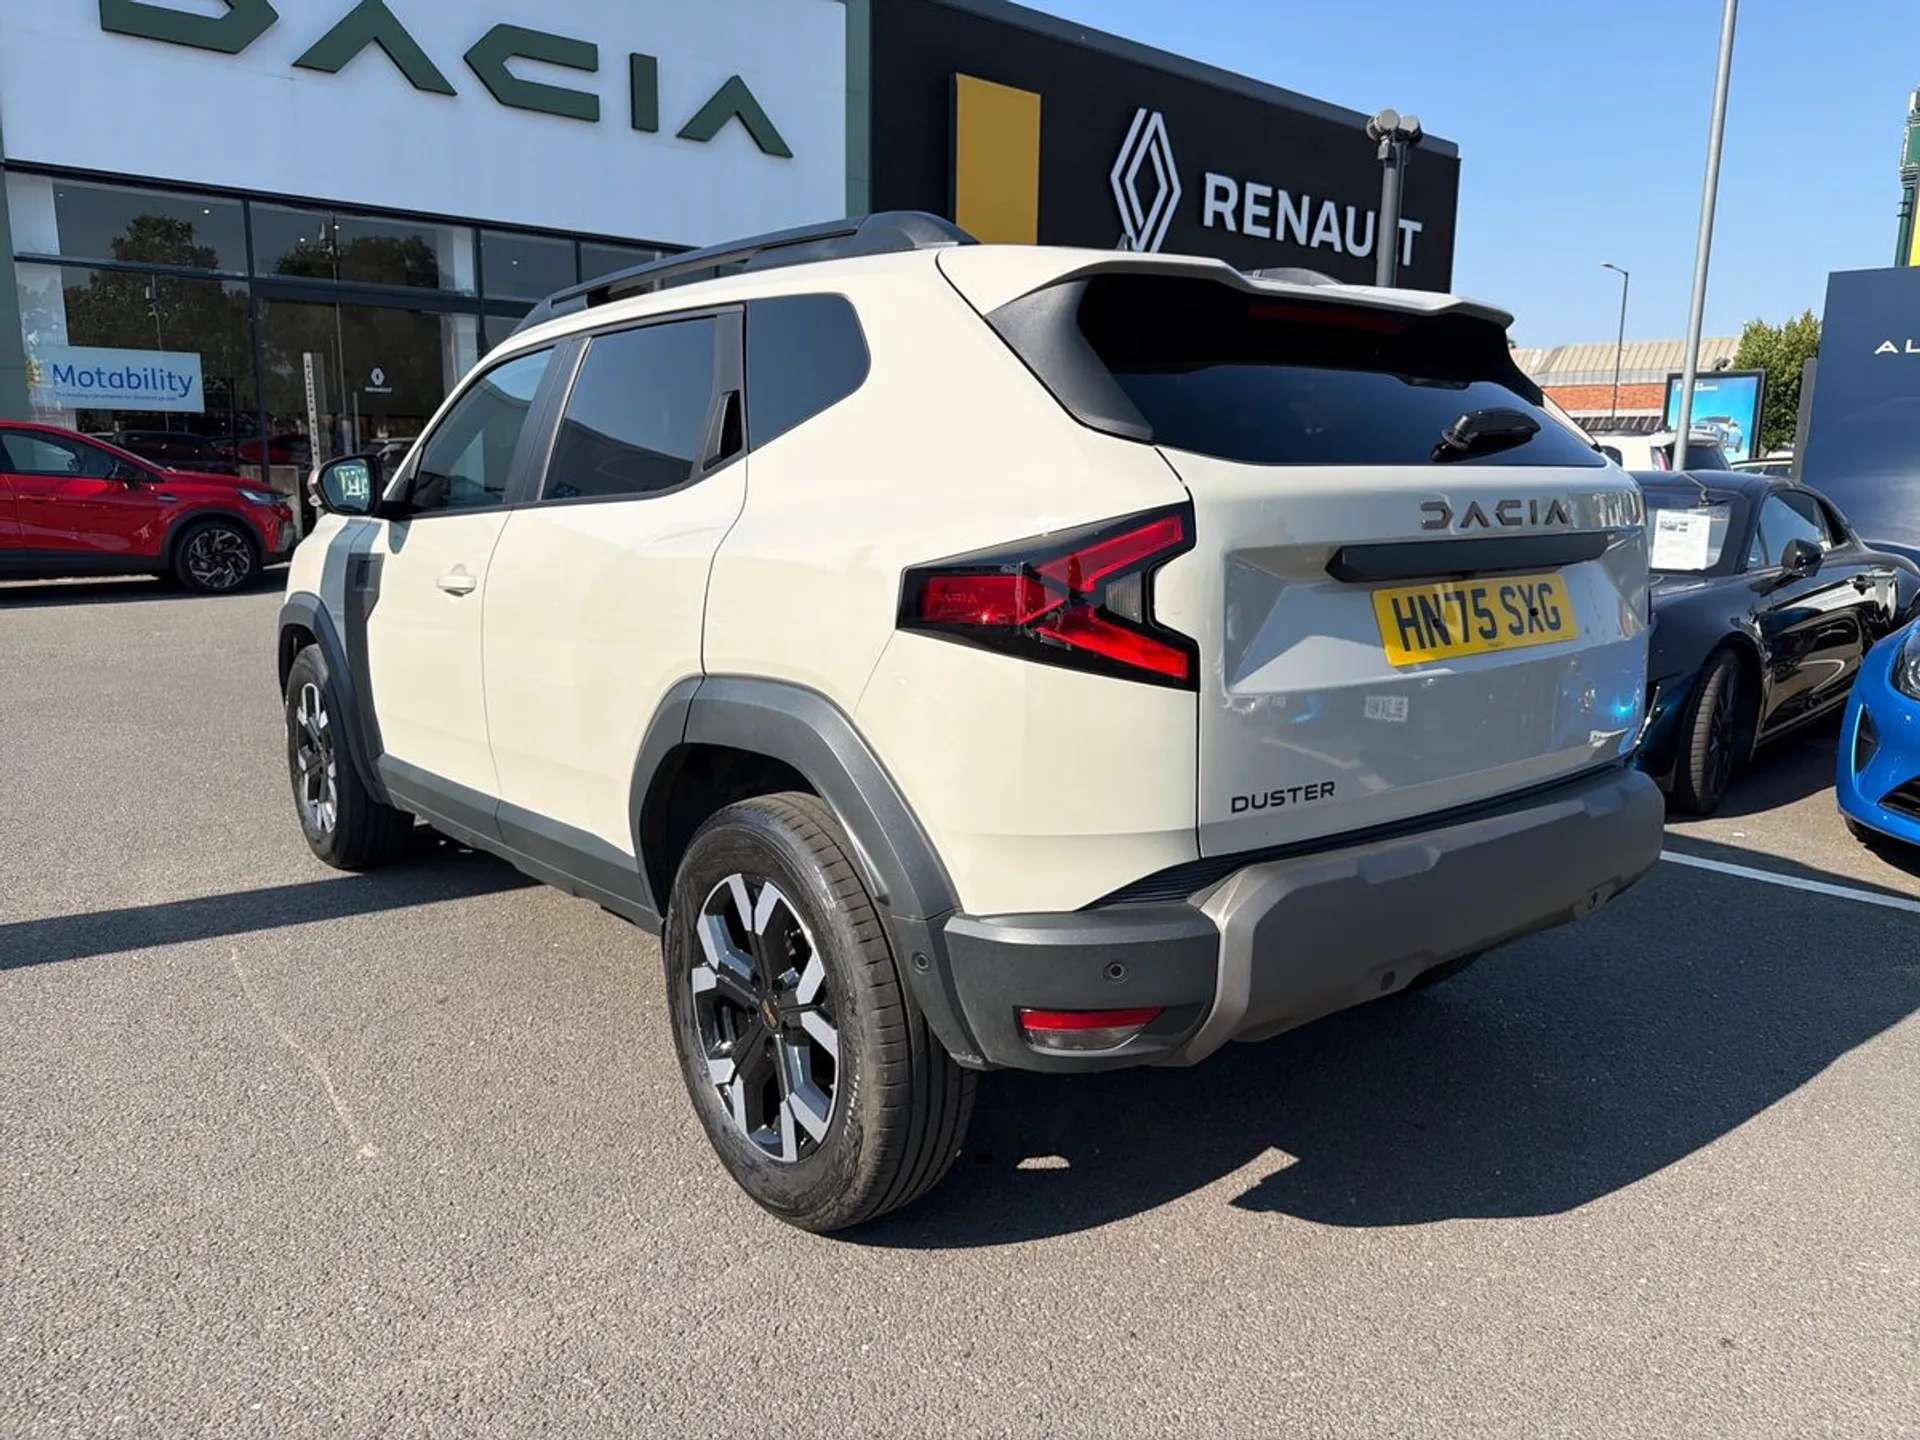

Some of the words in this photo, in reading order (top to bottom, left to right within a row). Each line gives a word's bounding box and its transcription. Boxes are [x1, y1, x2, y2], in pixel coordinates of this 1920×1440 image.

[1203, 172, 1422, 266] RENAUT
[52, 364, 193, 398] Motability
[1420, 500, 1569, 530] DACIA
[1392, 588, 1498, 652] HN75
[1500, 583, 1561, 636] SXG
[1231, 781, 1335, 813] DUSTER
